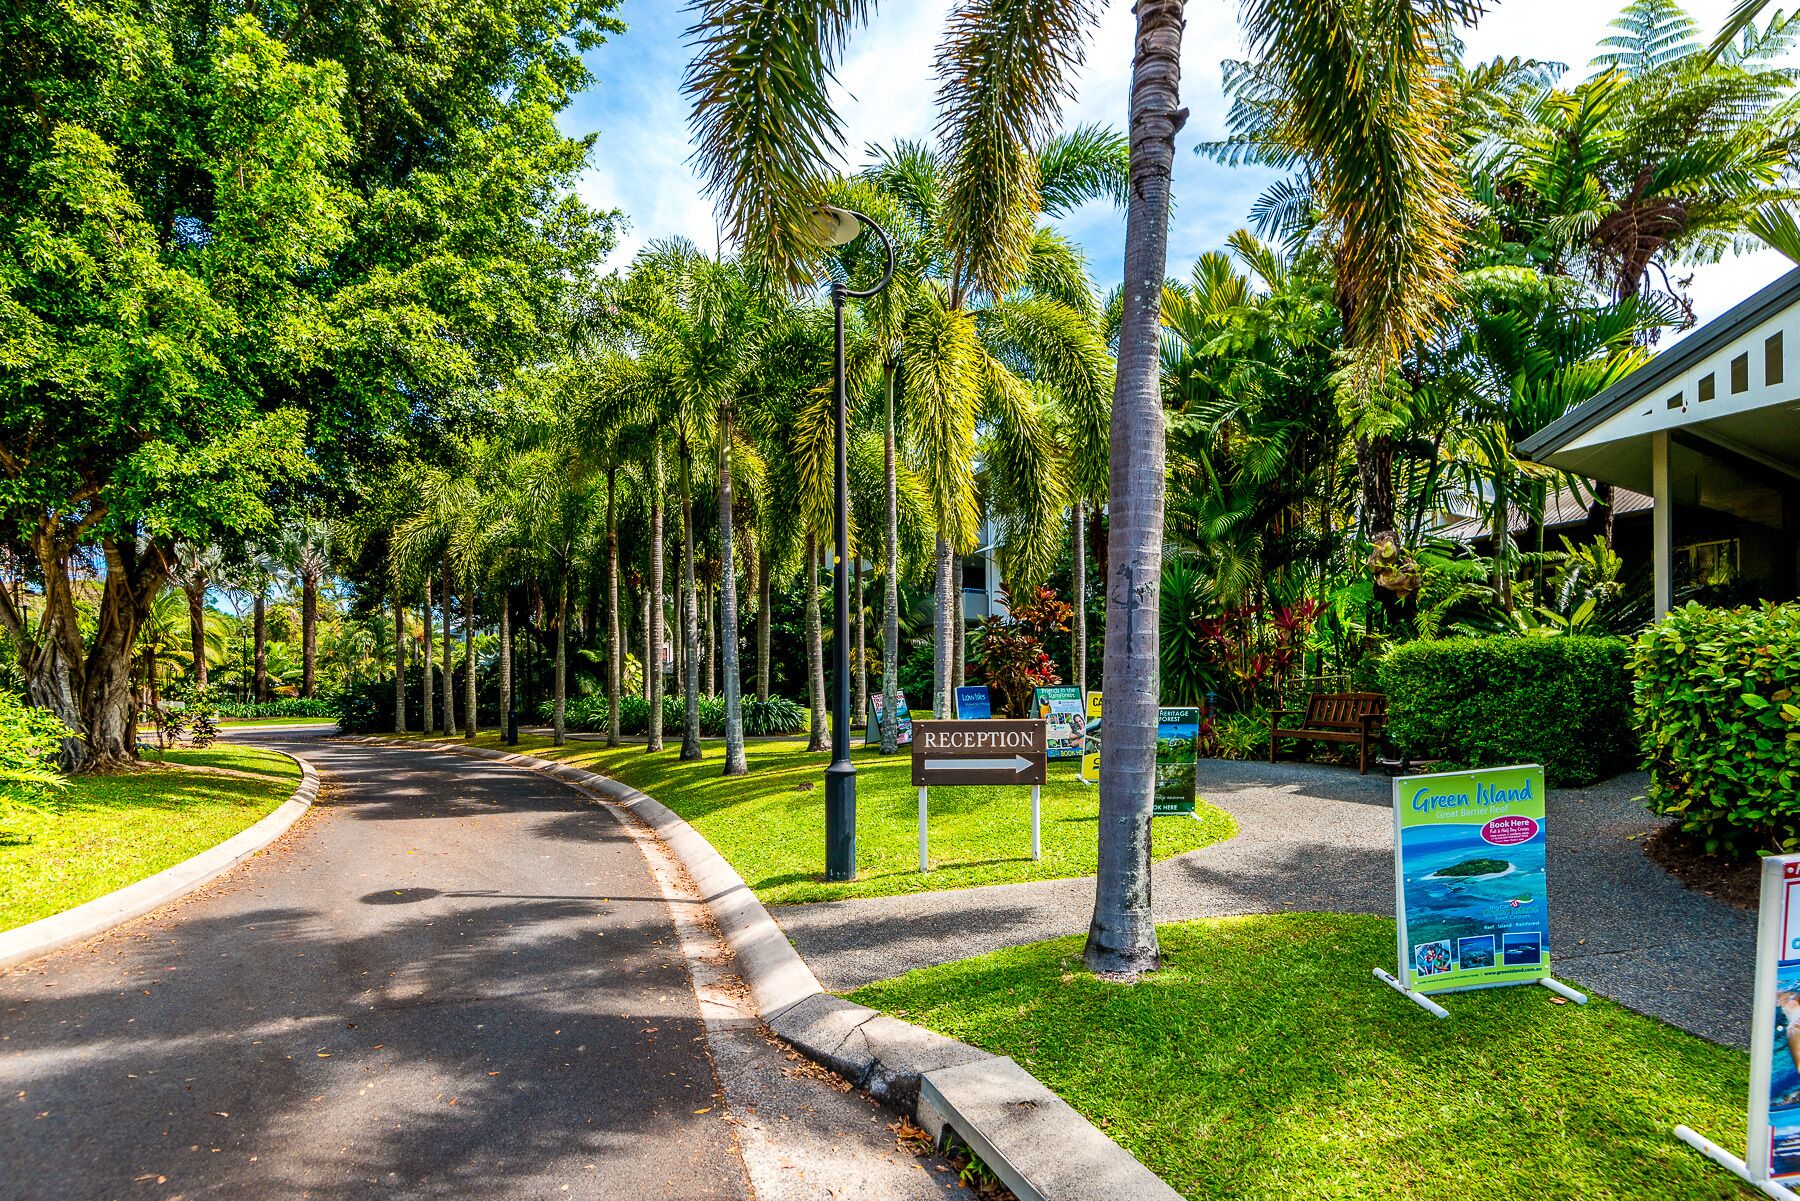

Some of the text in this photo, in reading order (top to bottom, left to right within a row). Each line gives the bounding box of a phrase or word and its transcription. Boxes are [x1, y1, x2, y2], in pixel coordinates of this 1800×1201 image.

[924, 731, 1034, 748] RECEPTION
[1412, 778, 1533, 814] Green Island
[1435, 804, 1509, 819] Great Barrier Reef
[1490, 819, 1530, 829] Book Here
